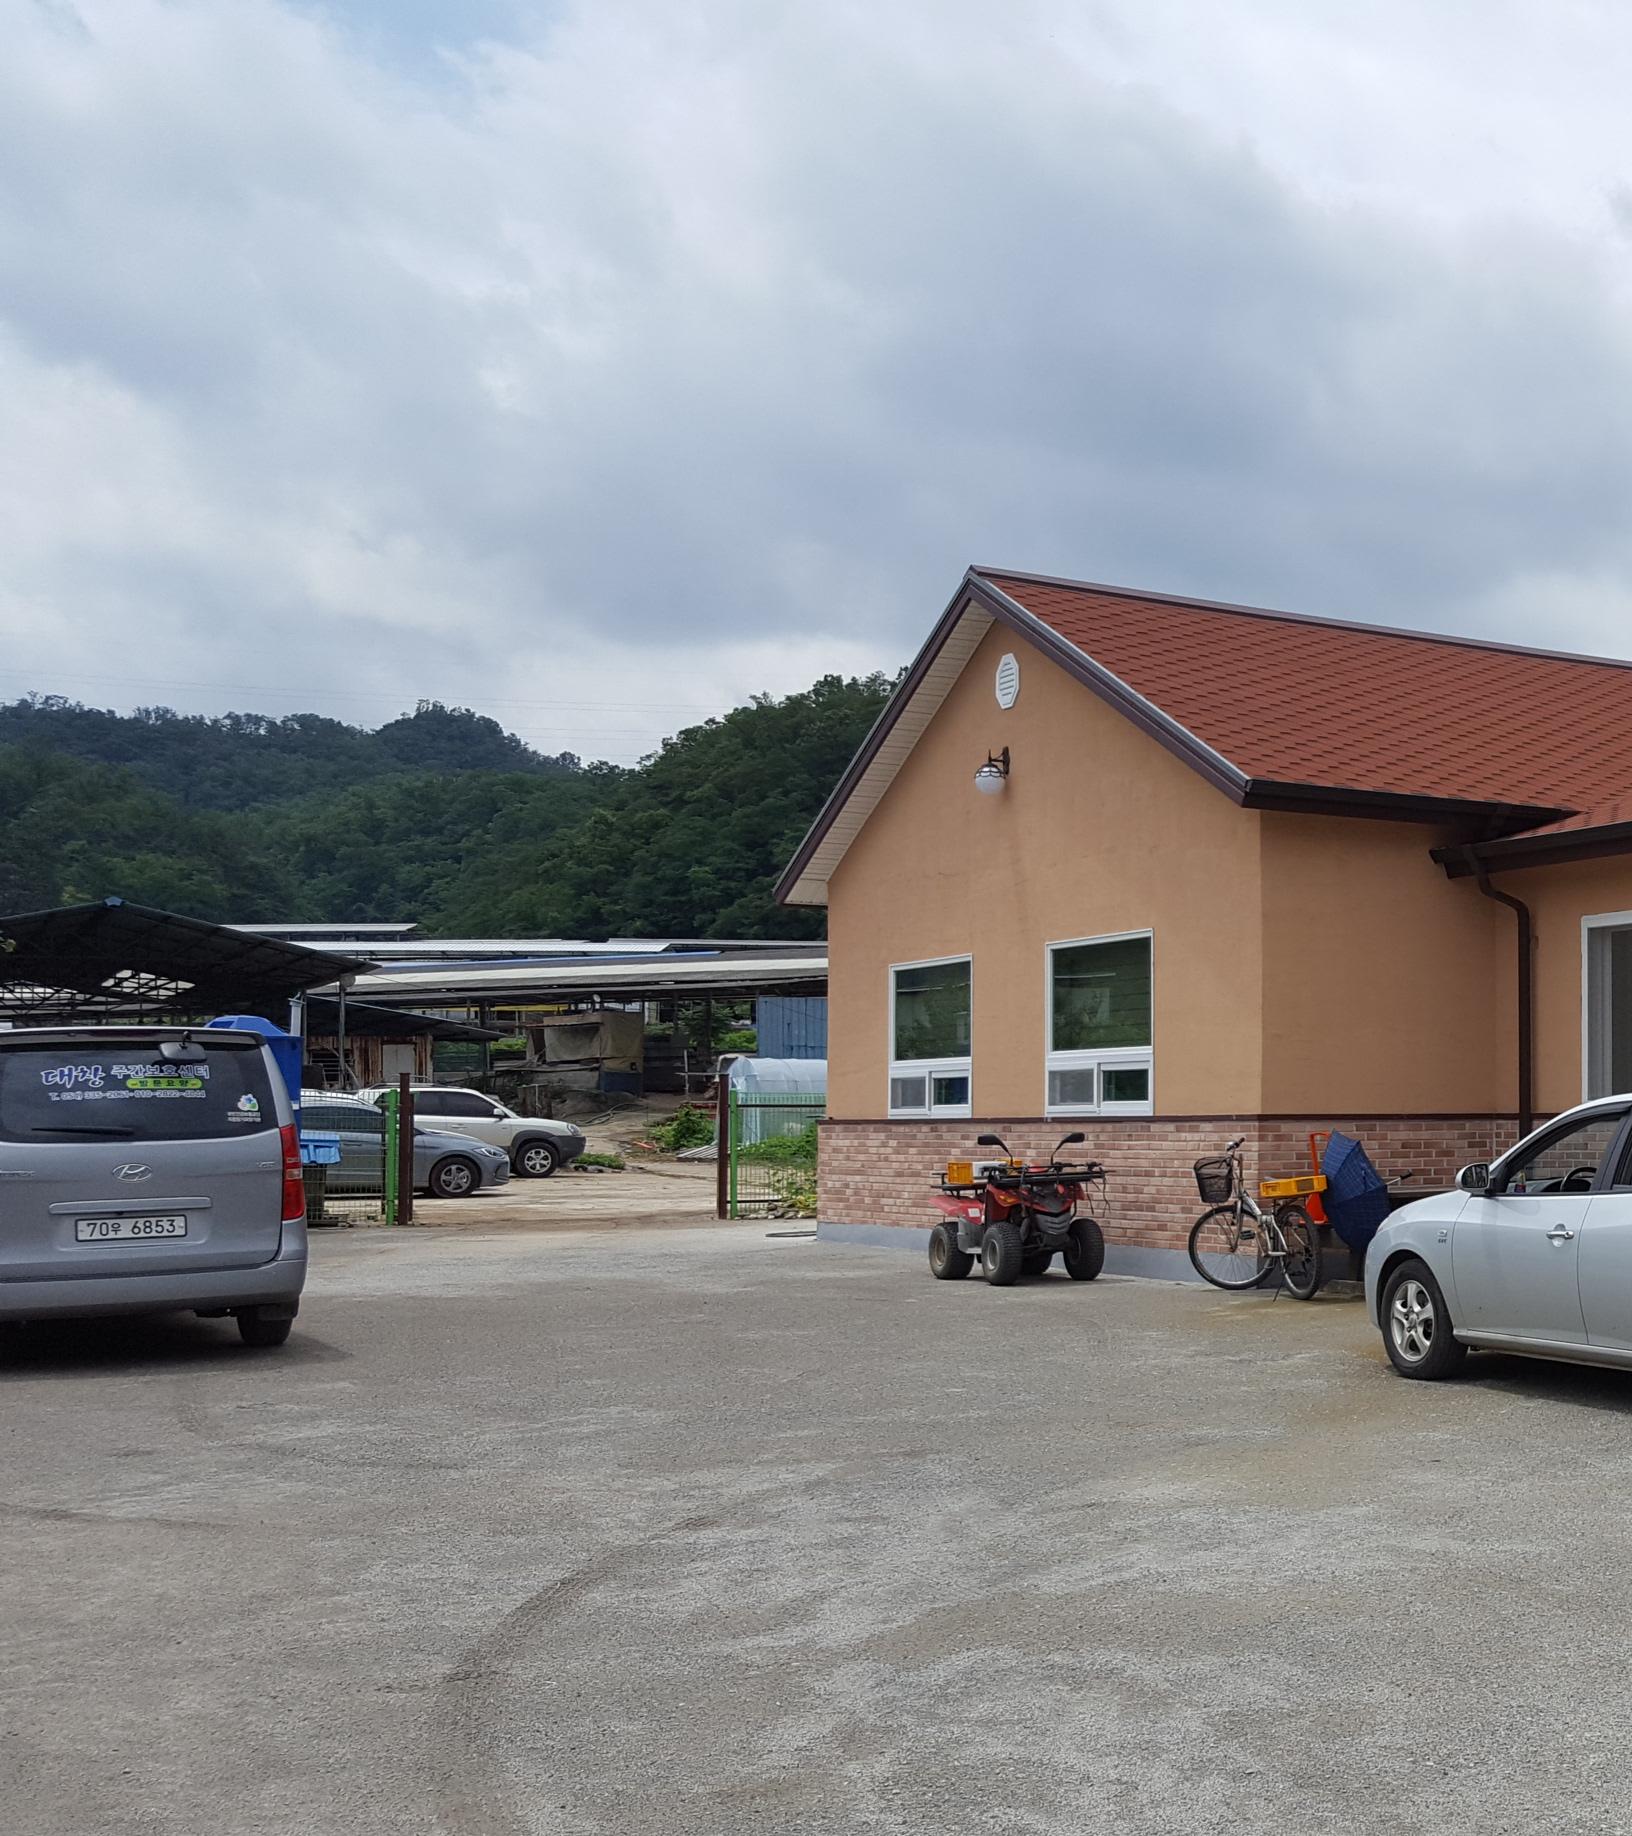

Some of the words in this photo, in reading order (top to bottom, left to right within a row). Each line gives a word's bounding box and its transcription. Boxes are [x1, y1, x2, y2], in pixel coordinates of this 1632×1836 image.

[40, 1065, 106, 1088] 대창
[110, 1064, 210, 1080] 주간보호센터
[87, 1222, 122, 1238] 70우
[131, 1219, 177, 1235] 6853
